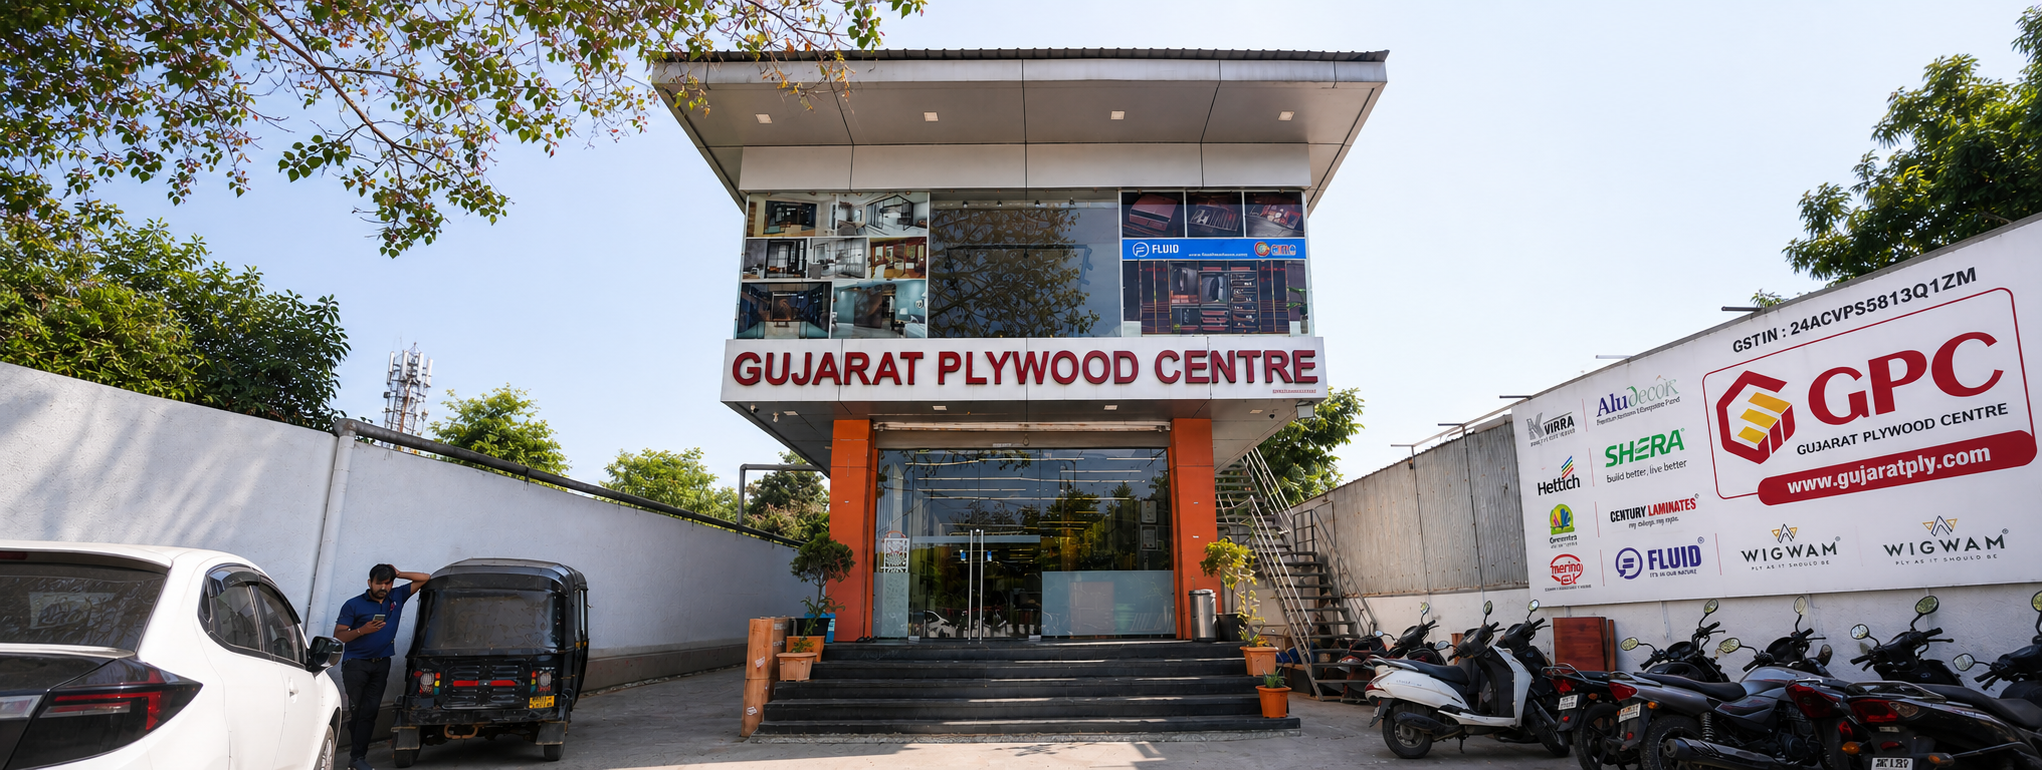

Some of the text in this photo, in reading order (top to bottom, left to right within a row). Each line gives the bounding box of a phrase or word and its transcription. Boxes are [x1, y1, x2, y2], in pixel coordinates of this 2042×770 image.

[1152, 244, 1179, 254] FLUID
[1732, 327, 1778, 353] GSTIN
[1790, 267, 1977, 336] 24ACVPS5813Q1ZM
[732, 349, 1319, 387] GUJARAT PLYWOOD CENTRE
[1808, 331, 2004, 426] GPC
[1544, 415, 1575, 435] VIRRA
[1796, 402, 2009, 456] GUJARAT PLYWOOD CENTRE
[1605, 429, 1685, 468] SHERA
[1606, 472, 1625, 483] build
[1649, 464, 1663, 475] live
[1663, 460, 1688, 472] better
[1787, 447, 1991, 494] www.gujaratply.com
[1537, 474, 1580, 496] Hettich
[1610, 505, 1646, 523] CENTURY
[1647, 497, 1696, 517] LAMINATES
[1647, 545, 1702, 570] FLUID
[1741, 541, 1837, 563] WIGWAM
[1883, 534, 2005, 557] WIGWAM
[1943, 554, 1982, 562] SHOULD
